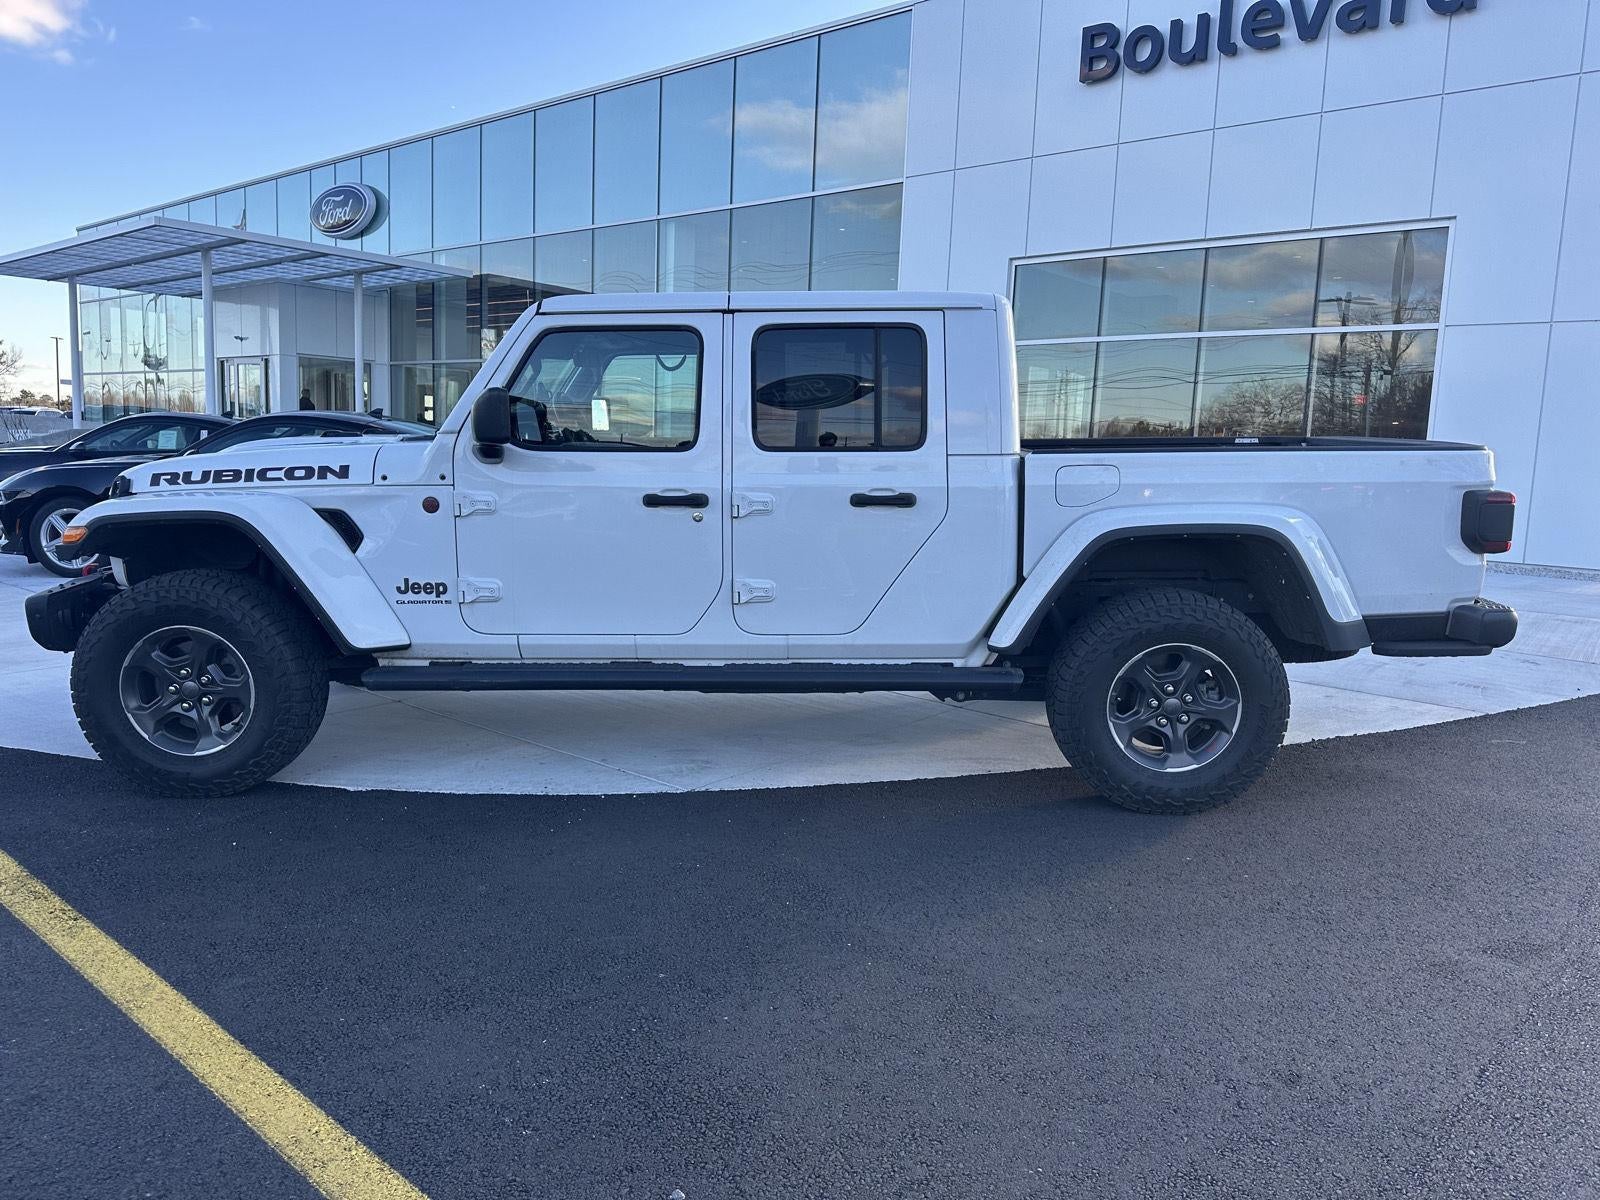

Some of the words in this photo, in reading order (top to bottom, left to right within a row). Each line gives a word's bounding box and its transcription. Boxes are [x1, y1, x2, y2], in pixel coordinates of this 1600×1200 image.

[1079, 0, 1477, 84] Bouleva
[319, 194, 353, 226] Ford
[149, 464, 350, 487] RUBICON
[395, 577, 448, 598] Jeep
